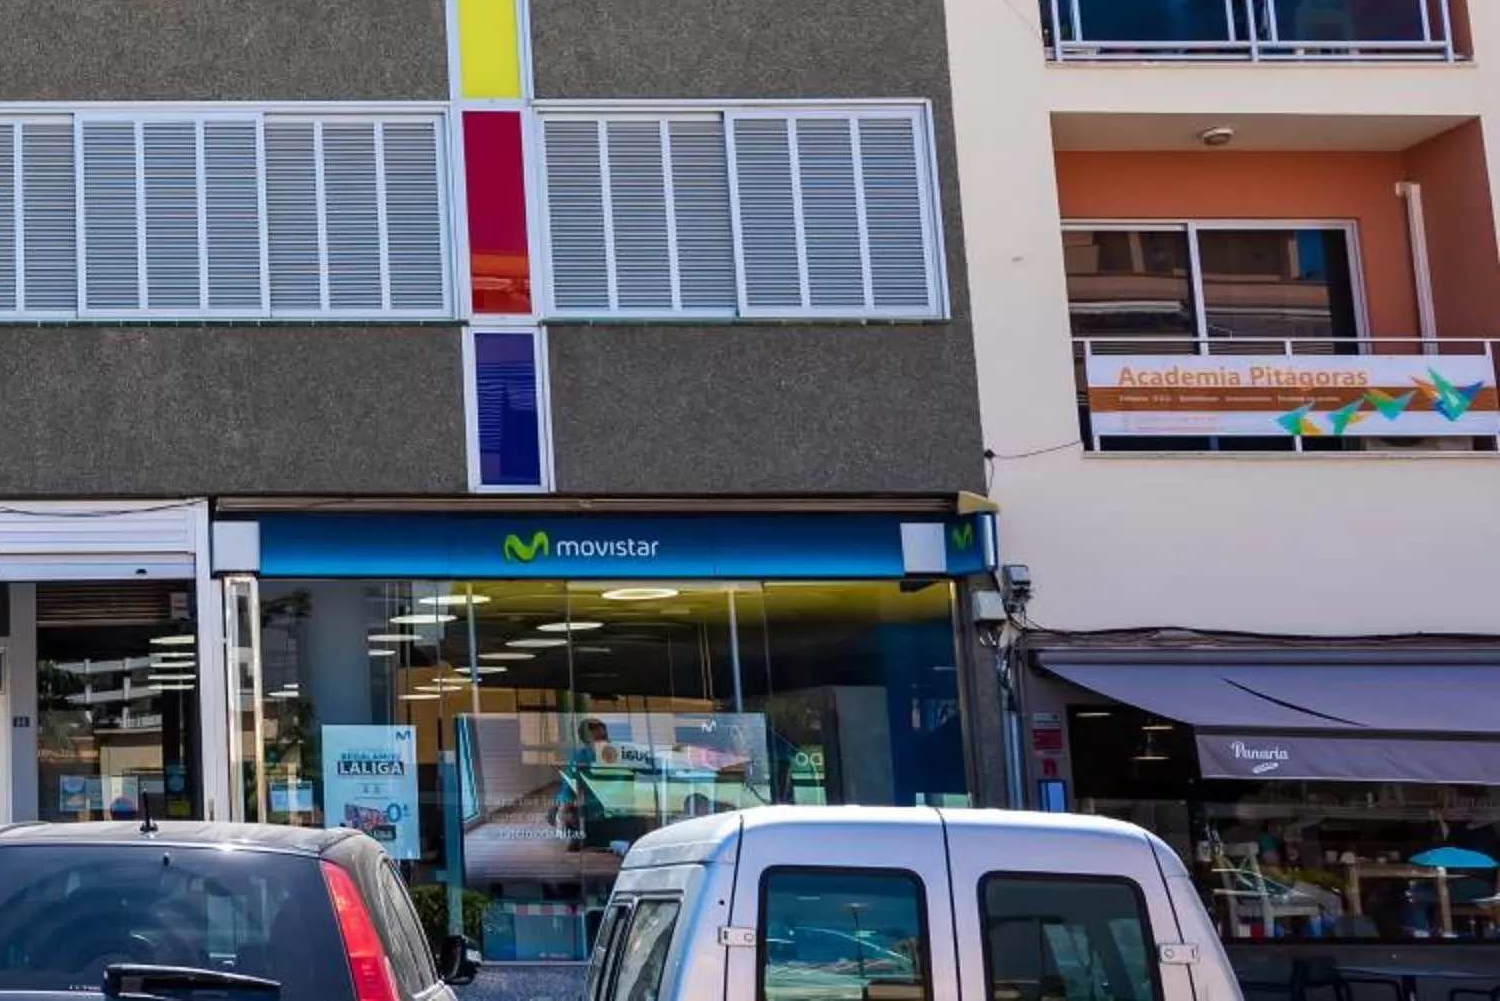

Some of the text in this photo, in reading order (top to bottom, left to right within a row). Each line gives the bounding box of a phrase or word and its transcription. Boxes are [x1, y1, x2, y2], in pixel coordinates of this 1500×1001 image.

[1118, 366, 1241, 387] Academia
[556, 538, 659, 557] movistar
[339, 762, 402, 774] LALIGA
